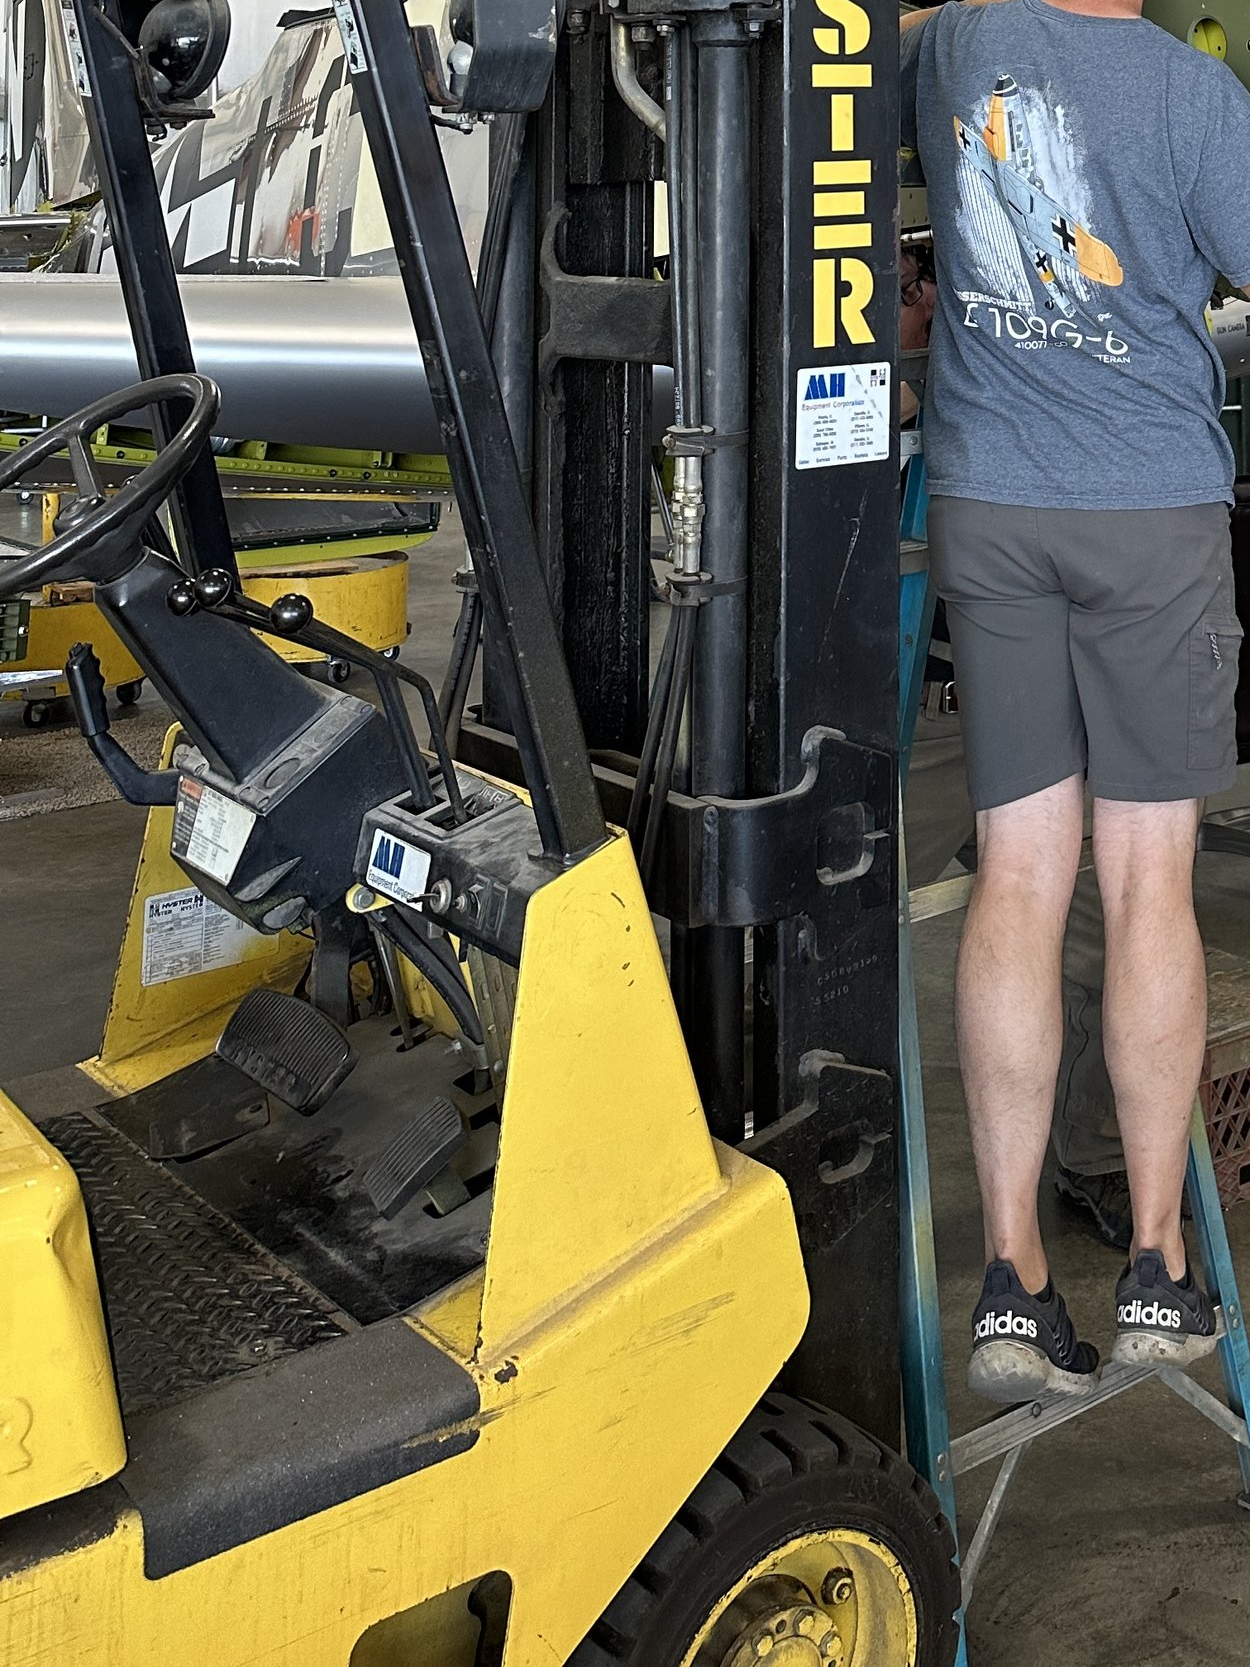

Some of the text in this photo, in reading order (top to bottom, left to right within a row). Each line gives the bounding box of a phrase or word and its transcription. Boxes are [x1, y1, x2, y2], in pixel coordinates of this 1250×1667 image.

[1216, 323, 1246, 334] GUN CAMERA
[1014, 340, 1048, 350] 410077
[804, 372, 846, 401] MH
[802, 400, 865, 411] Equipment Corporation
[161, 897, 193, 910] HYSTER
[1117, 1299, 1181, 1329] adidas
